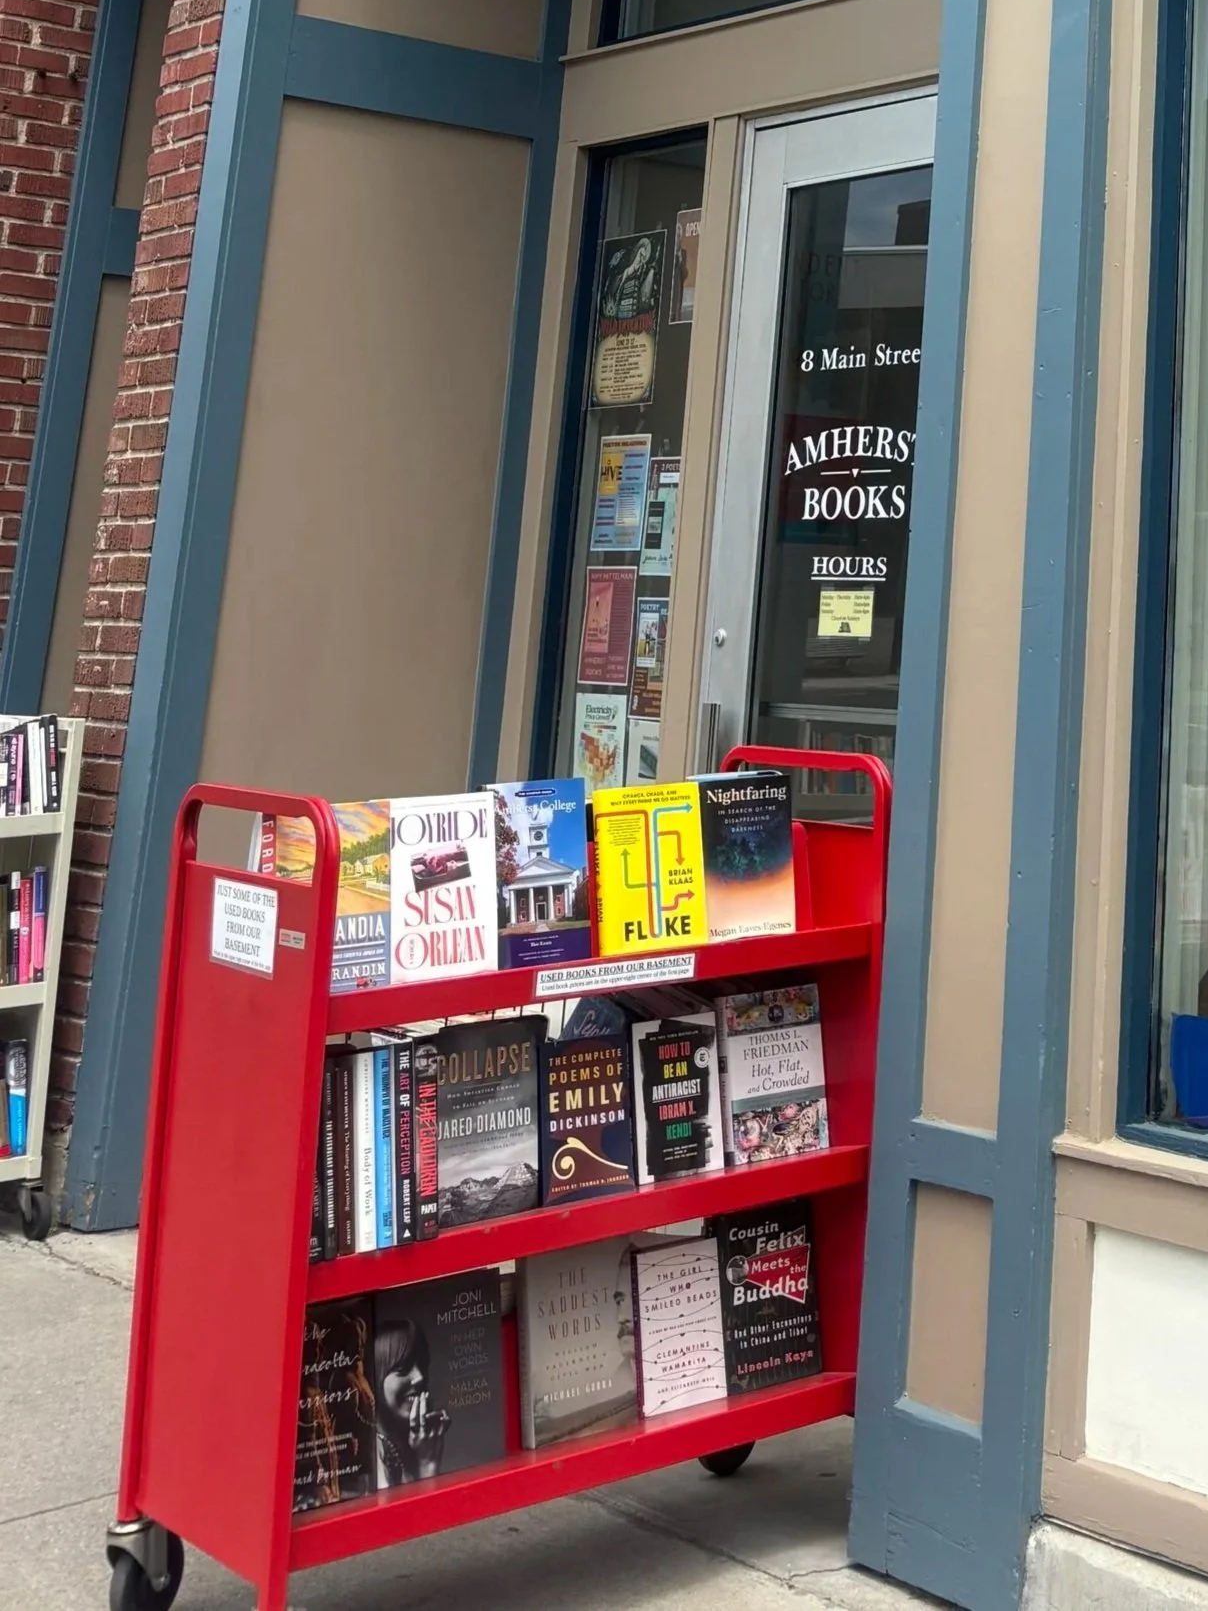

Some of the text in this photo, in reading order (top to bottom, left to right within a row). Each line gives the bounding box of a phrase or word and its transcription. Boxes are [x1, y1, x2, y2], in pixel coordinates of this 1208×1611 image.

[801, 349, 814, 372] 8
[820, 346, 866, 371] Main
[784, 425, 916, 476] AMHERS
[802, 485, 906, 520] BOOKS
[811, 556, 887, 576] HOURS
[585, 704, 612, 716] Electricity
[706, 785, 787, 805] Nightfaring
[390, 808, 488, 850] JOYRIDE
[724, 815, 770, 824] DISAPPEARING
[731, 825, 763, 833] DARKNESS
[261, 820, 275, 874] FORD
[217, 884, 275, 908] JUST SOME OF THE
[404, 885, 476, 927] SUSAN
[224, 902, 266, 923] USED BOOKS
[226, 920, 262, 939] FROM OUR
[224, 937, 261, 957] BASEMENT
[394, 925, 485, 970] ORLEAN
[540, 956, 693, 983] USED BOOKS FROM OUR BASEMENT
[548, 1048, 623, 1067] THE COMPLETE
[658, 1041, 691, 1060] HOW TO
[743, 1039, 810, 1061] FRIEDMAN
[438, 1042, 531, 1086] COLLAPSE
[549, 1063, 624, 1086] POEMS OF
[664, 1060, 688, 1079] BE AN
[549, 1082, 624, 1113] EMILY
[652, 1079, 701, 1101] ANTIRACIST
[550, 1109, 626, 1132] DICKINSON
[659, 1100, 697, 1121] IBRAM X.
[438, 1106, 531, 1141] JARED DIAMOND
[665, 1121, 692, 1140] KENDI
[399, 1050, 411, 1224] THE ART OF PERCEPTION ROBERT LEAF
[418, 1083, 437, 1198] IN THE CAULDRON
[728, 1221, 779, 1241] Cousin
[755, 1231, 804, 1255] Felix
[657, 1265, 702, 1282] THE GIRL
[751, 1256, 807, 1274] Meets the
[453, 1289, 482, 1307] JONI
[669, 1282, 691, 1293] WHO
[733, 1277, 809, 1306] Buddha
[538, 1287, 609, 1319] SADDEST
[645, 1290, 717, 1313] SMILED BEADS
[437, 1302, 497, 1326] MITCHELL
[548, 1314, 602, 1341] WORDS
[734, 1314, 812, 1339] And Other Encounters
[454, 1342, 481, 1357] OWN
[656, 1341, 710, 1359] CLEMANTINE
